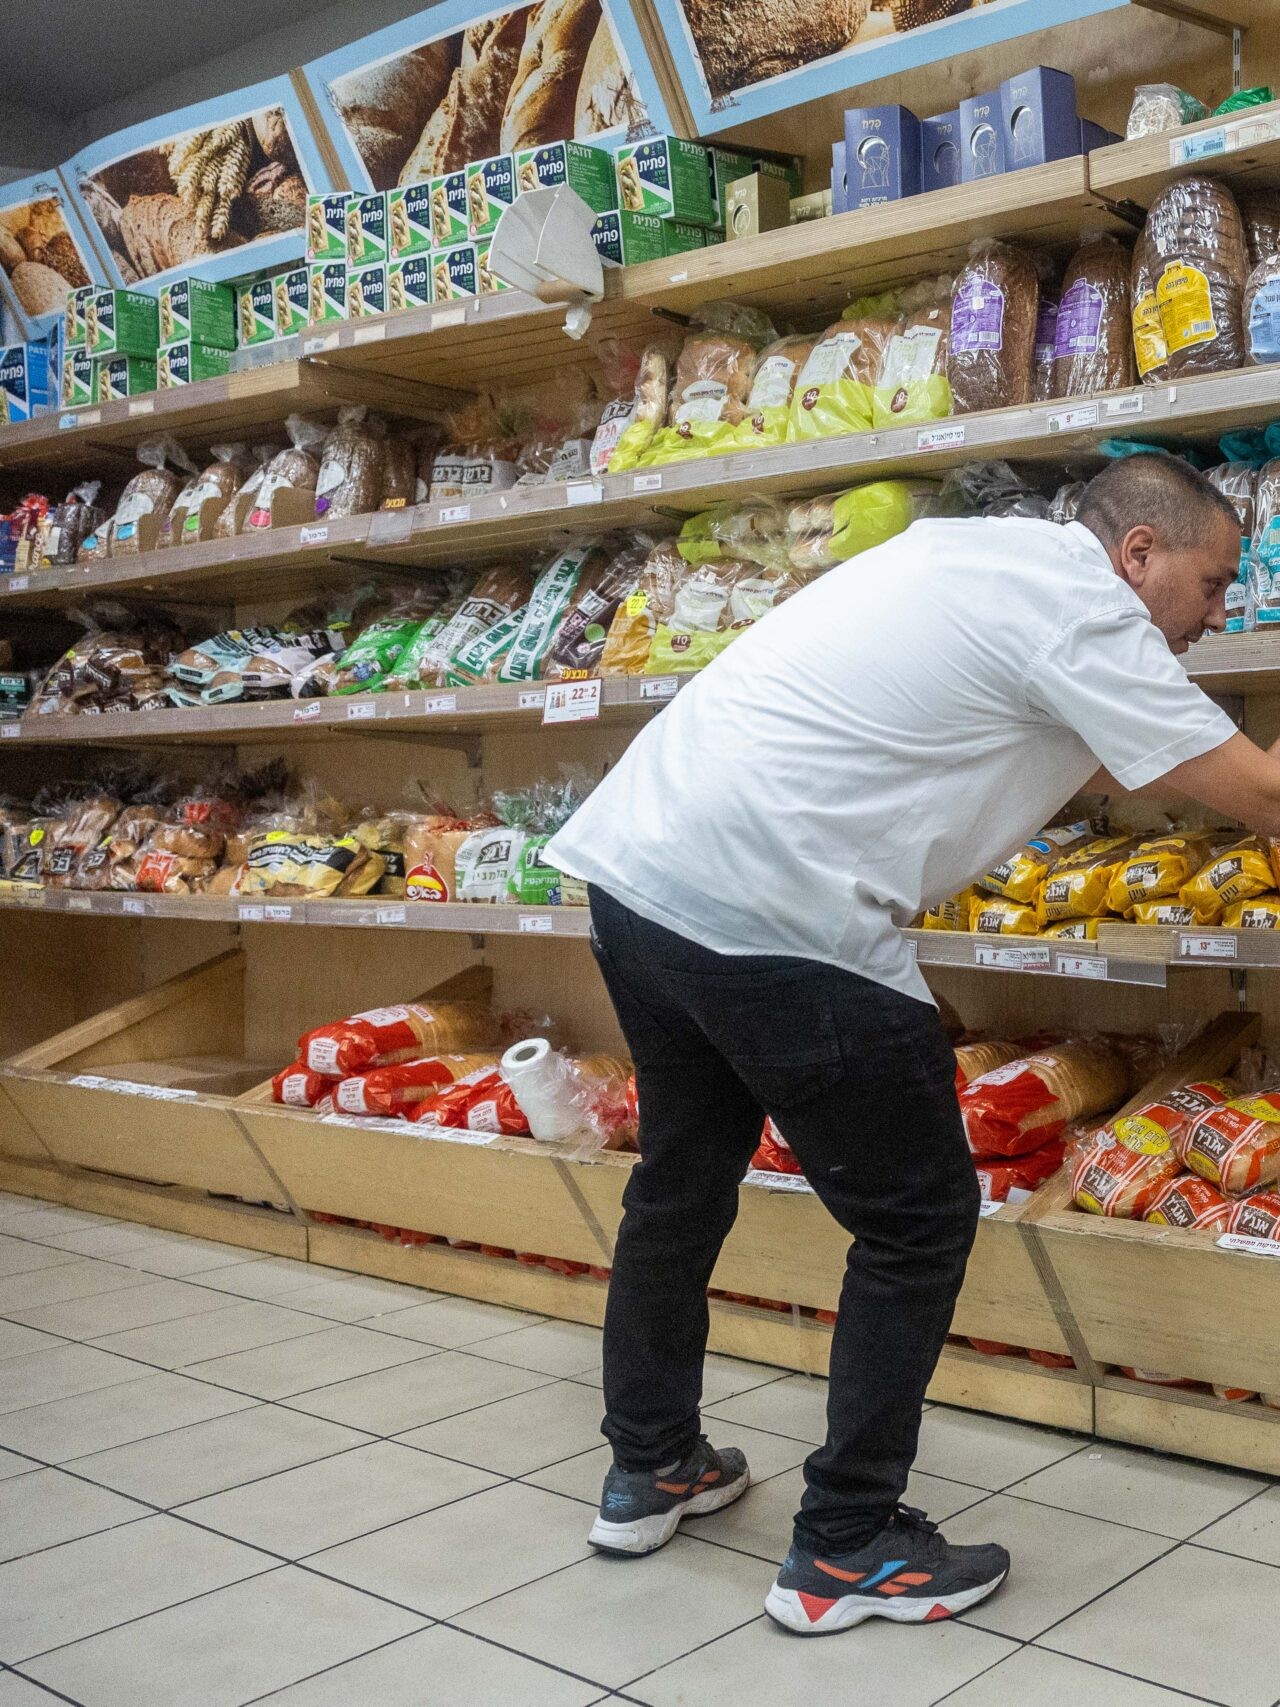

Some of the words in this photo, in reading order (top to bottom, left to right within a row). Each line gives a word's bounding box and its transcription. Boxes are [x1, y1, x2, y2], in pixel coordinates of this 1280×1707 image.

[568, 145, 593, 158] PATIT
[538, 161, 564, 177] פתית
[638, 156, 665, 174] פתית
[486, 172, 511, 188] פתית
[407, 198, 428, 213] פתית
[362, 209, 383, 223] פתית
[450, 263, 473, 277] פתית
[190, 279, 217, 293] PATIT
[404, 272, 426, 286] פתית
[1197, 1129, 1225, 1154] אנג'ל
[1240, 1211, 1268, 1232] אנג'ל
